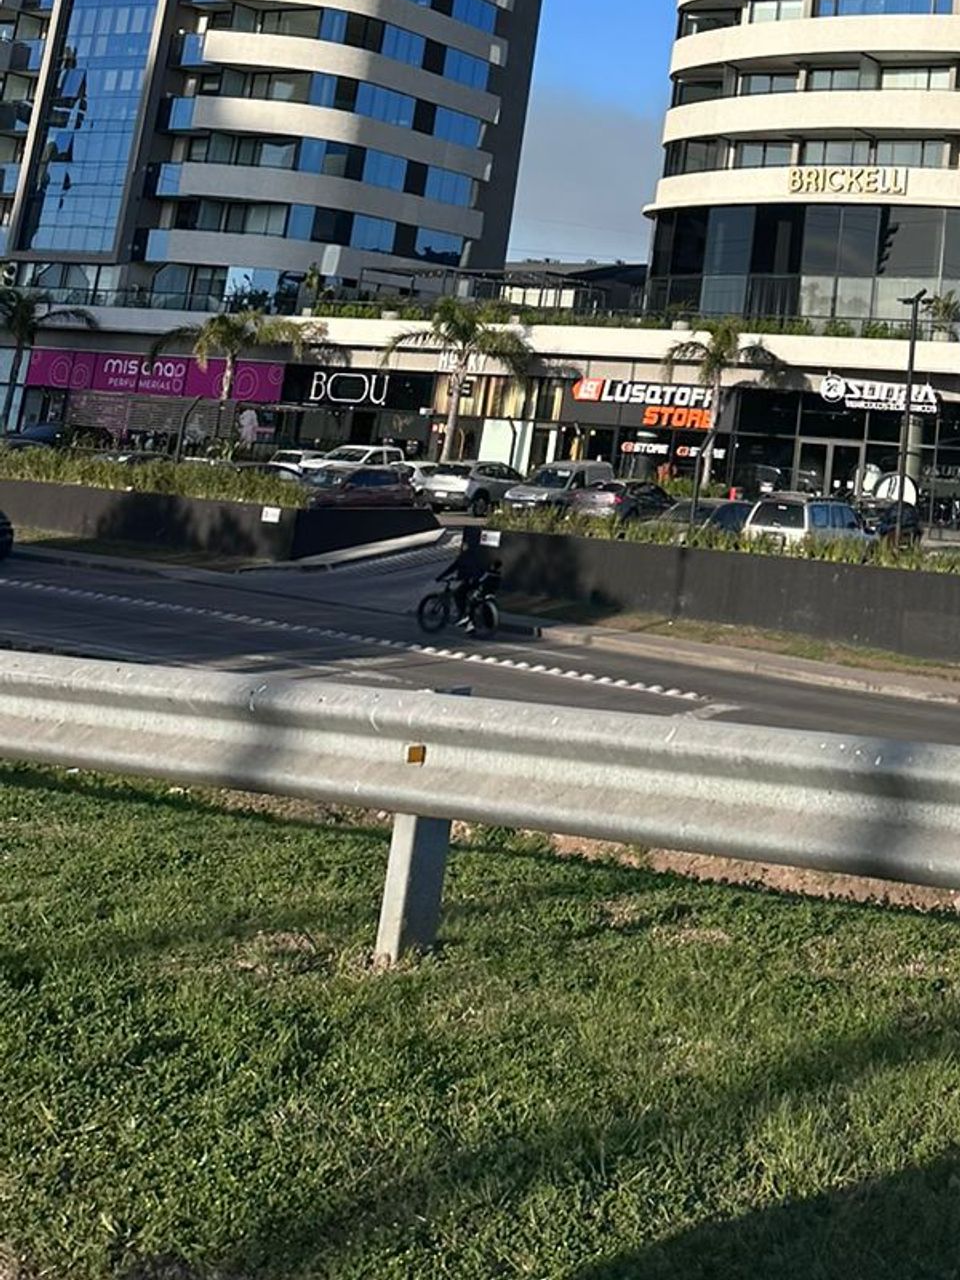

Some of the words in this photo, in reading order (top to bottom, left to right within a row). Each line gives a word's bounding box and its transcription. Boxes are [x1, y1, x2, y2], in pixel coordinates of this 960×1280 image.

[789, 167, 905, 194] BRICKELL
[309, 371, 389, 406] BOU
[642, 405, 716, 429] STORE
